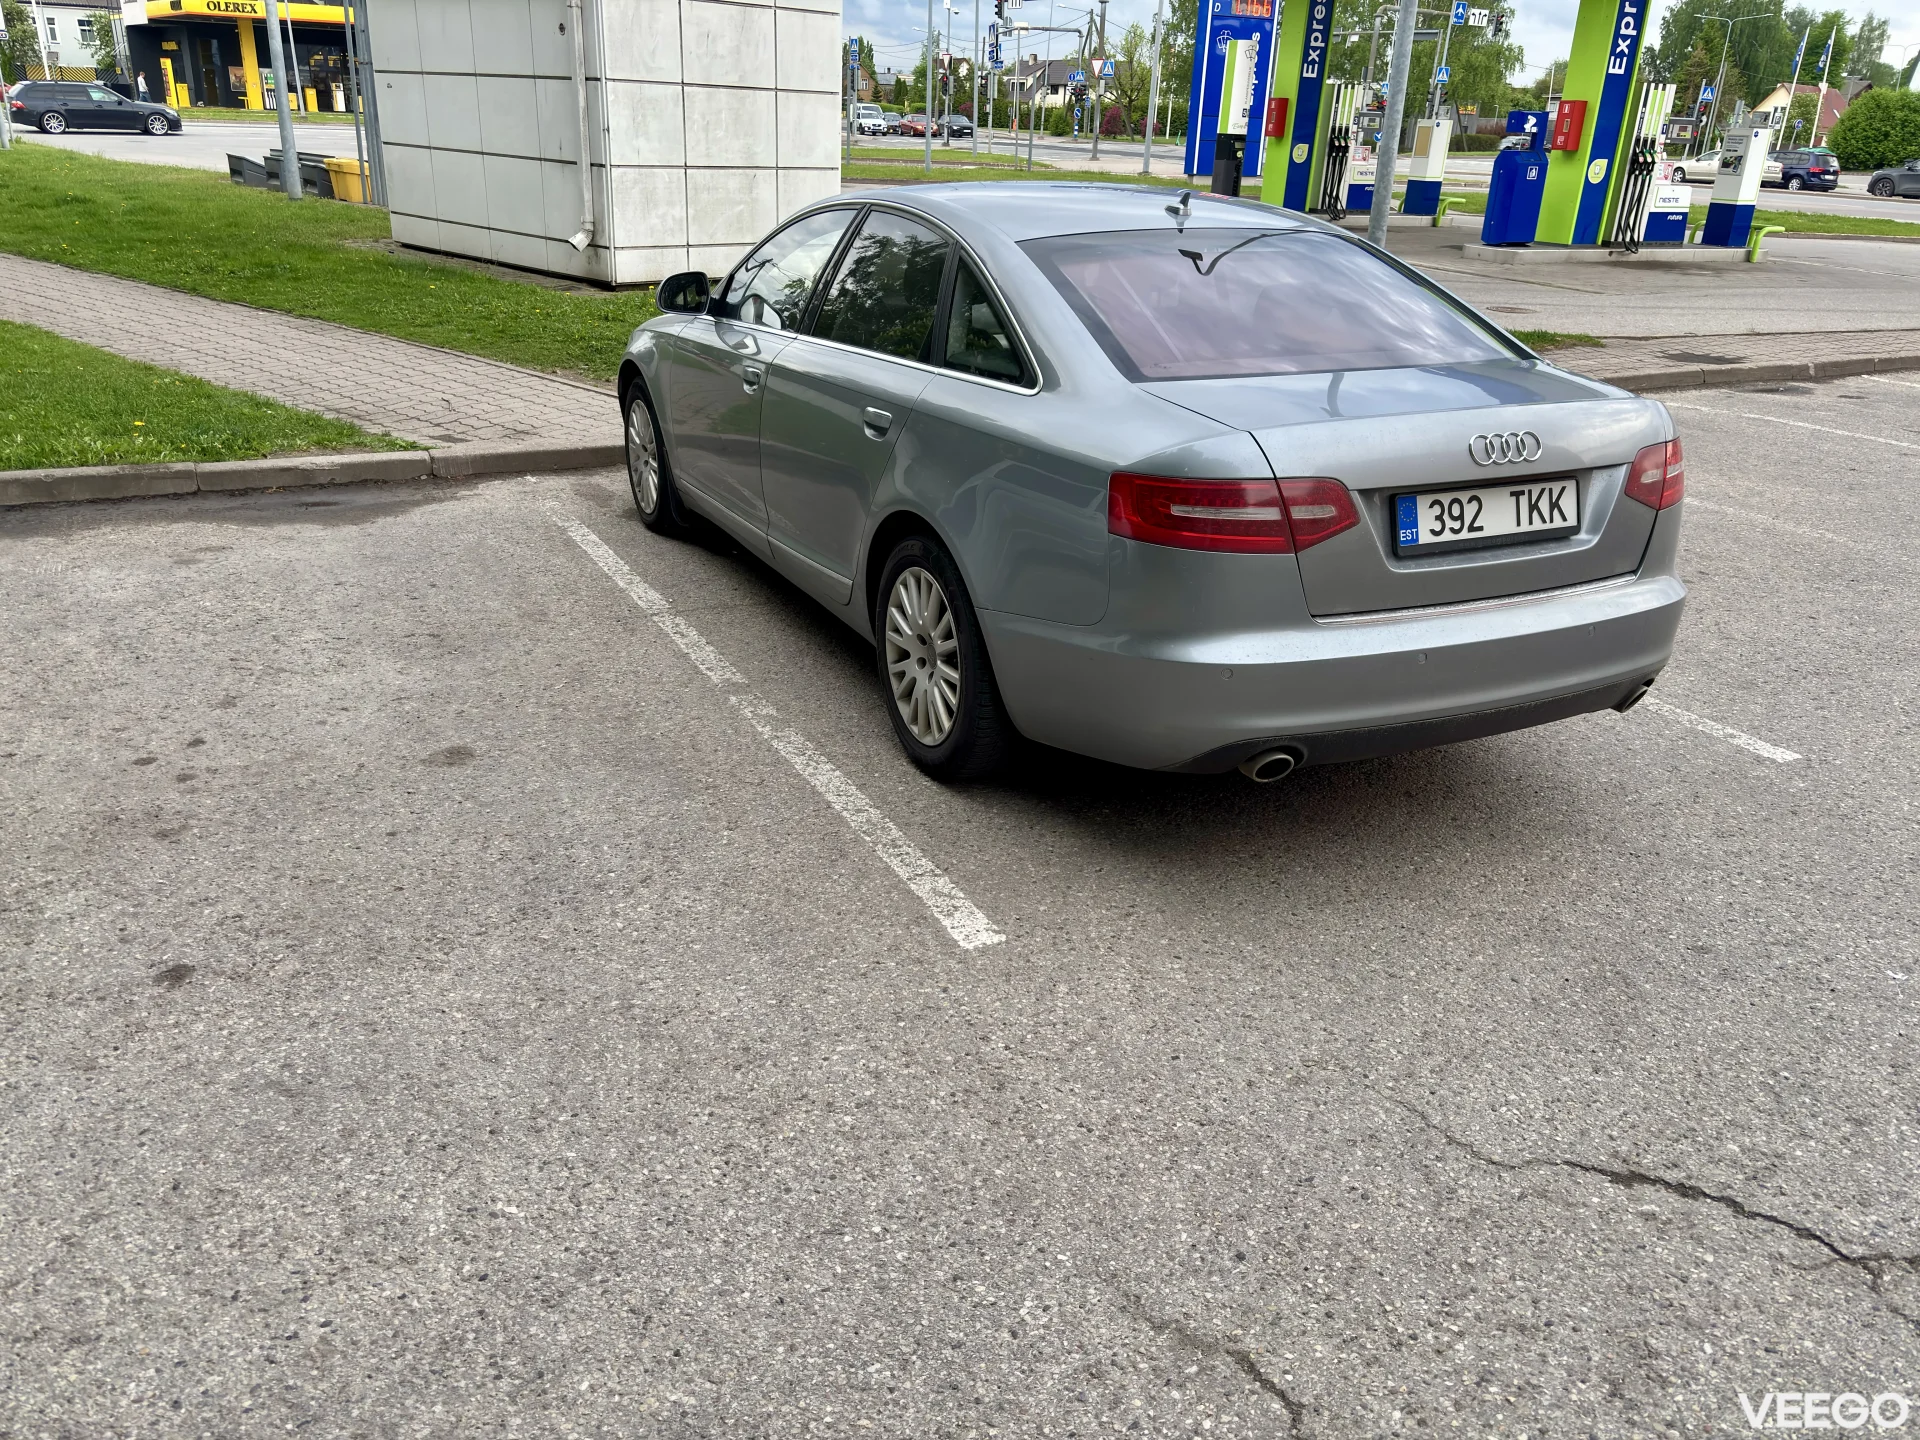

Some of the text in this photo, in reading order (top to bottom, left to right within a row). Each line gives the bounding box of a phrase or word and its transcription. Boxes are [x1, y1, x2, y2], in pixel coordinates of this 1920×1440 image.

[206, 0, 258, 14] OLEREX
[1213, 2, 1222, 13] D
[1302, 0, 1327, 78] Expre
[1607, 1, 1637, 75] Expr
[1428, 485, 1568, 537] 392 TKK
[1400, 529, 1417, 542] EST
